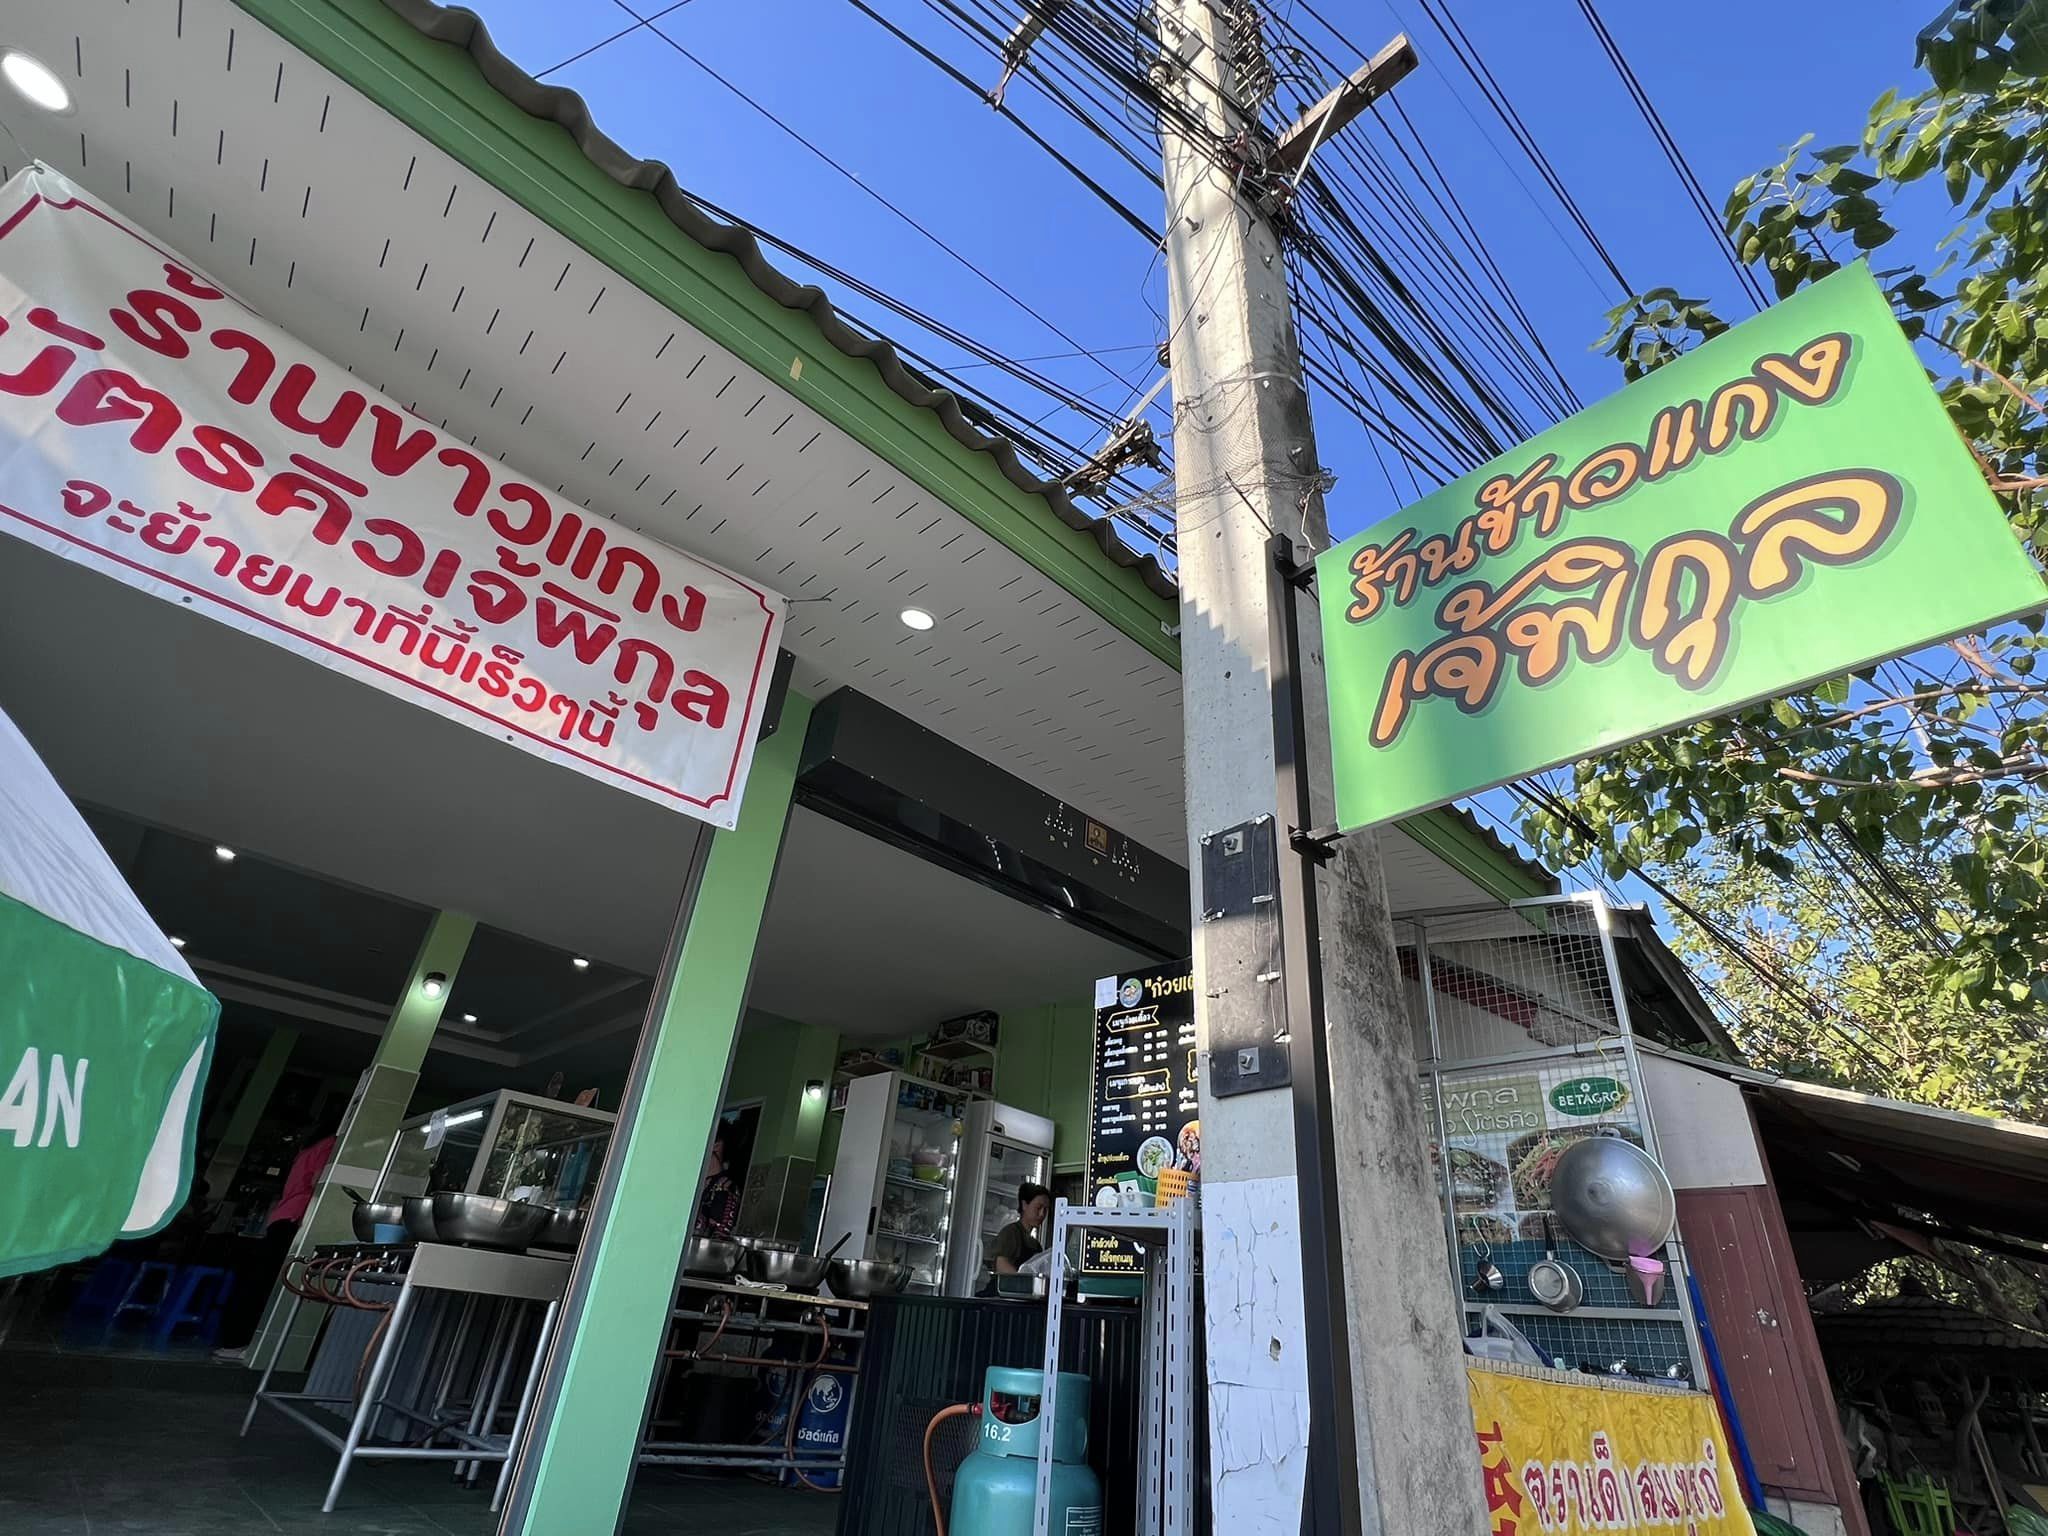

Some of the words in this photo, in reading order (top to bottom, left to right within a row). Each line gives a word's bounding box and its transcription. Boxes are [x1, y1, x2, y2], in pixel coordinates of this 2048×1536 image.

[109, 262, 707, 632] ร้านขาวแกง
[1346, 332, 1852, 623] ร้านข้าวแกง
[1369, 468, 1904, 748] เจ้พิกุล
[1558, 1089, 1622, 1107] BETAGRO
[984, 1422, 1012, 1442] 16.2
